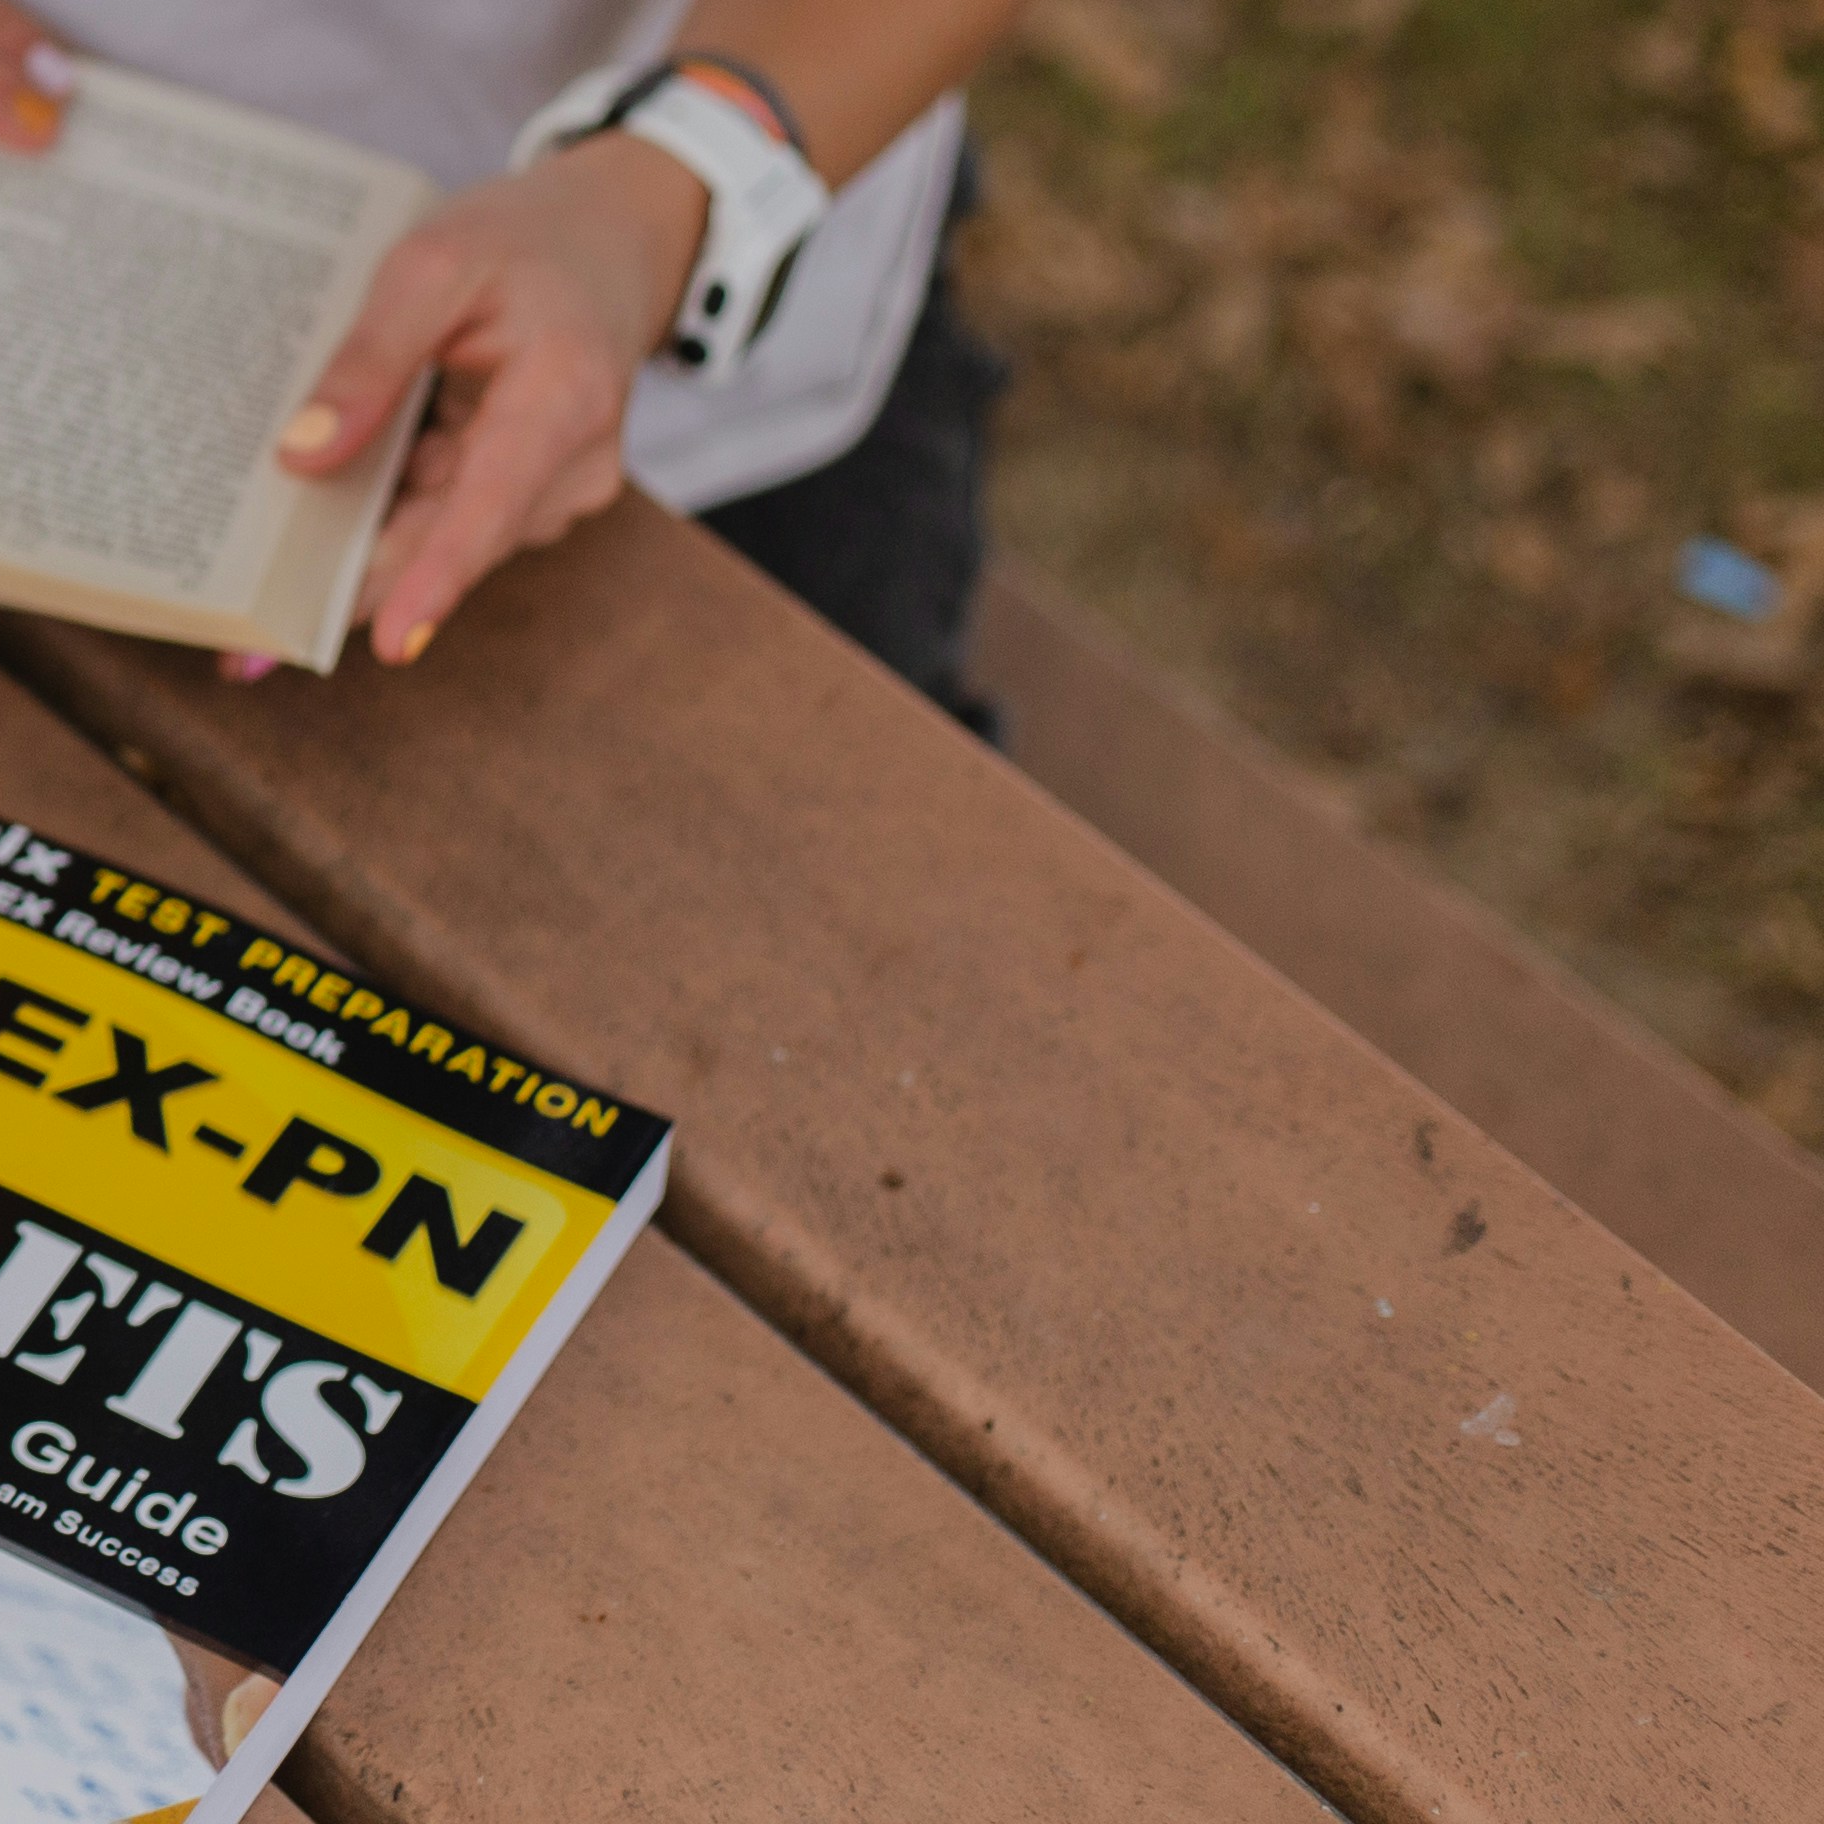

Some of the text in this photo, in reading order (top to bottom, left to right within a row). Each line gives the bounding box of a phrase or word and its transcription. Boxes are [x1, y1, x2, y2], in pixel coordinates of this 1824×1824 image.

[54, 910, 222, 1000] Review
[225, 987, 344, 1065] Book
[91, 870, 228, 945] TEST
[240, 939, 619, 1137] PREPARATION
[11, 1420, 229, 1556] Guide
[53, 1509, 200, 1596] Success
